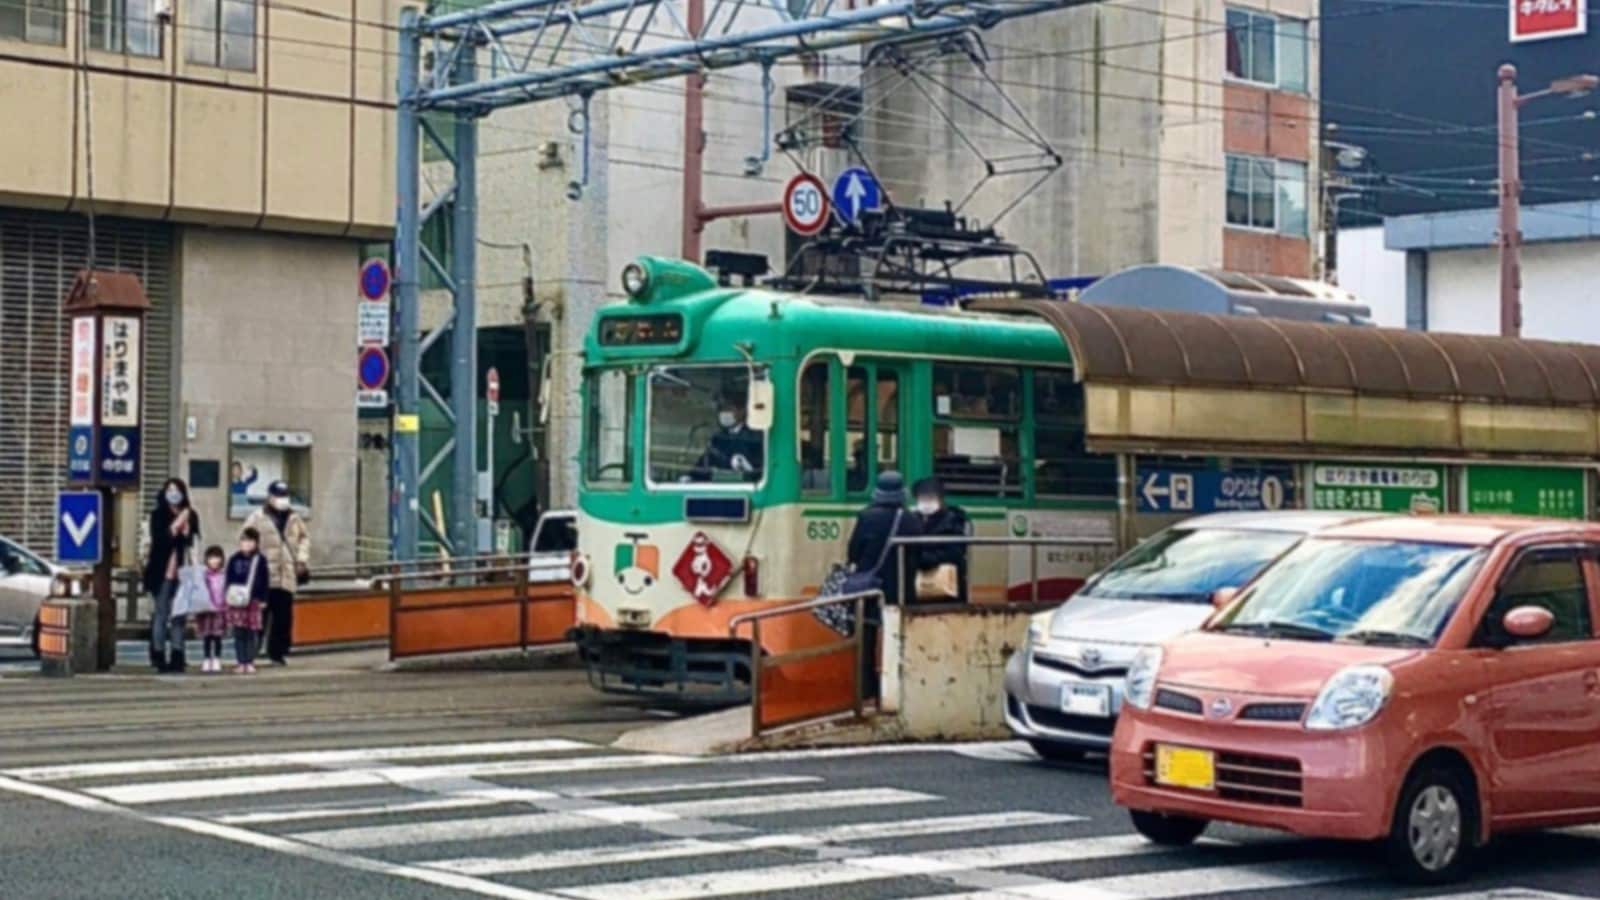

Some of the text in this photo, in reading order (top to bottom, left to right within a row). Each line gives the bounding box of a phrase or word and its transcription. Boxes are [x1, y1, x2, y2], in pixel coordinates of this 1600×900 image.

[794, 189, 819, 216] 50
[1221, 474, 1260, 498] のりば
[806, 521, 840, 540] 630
